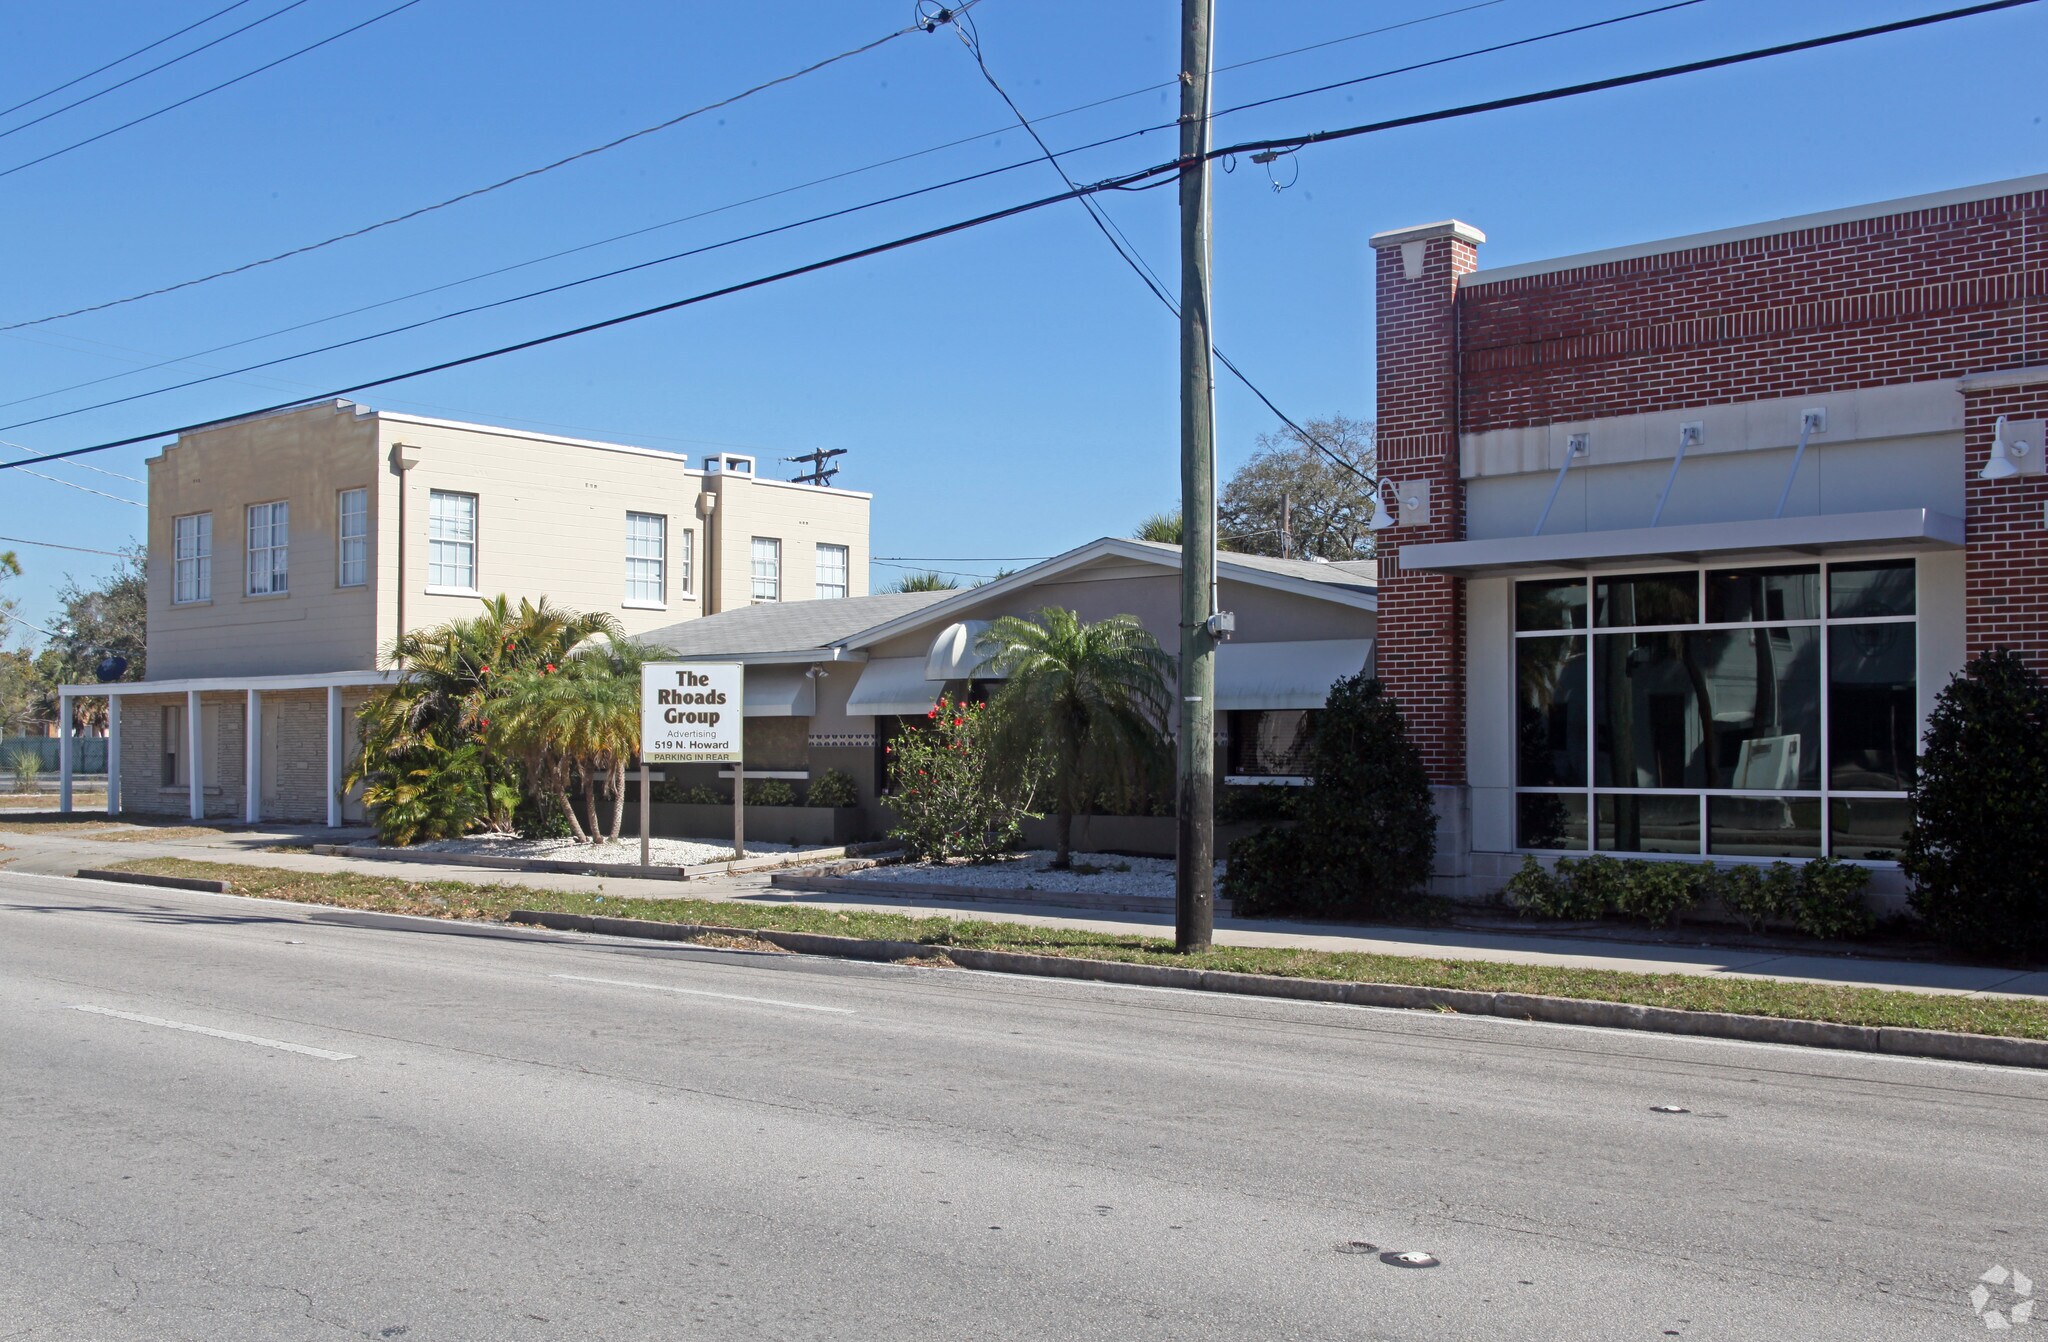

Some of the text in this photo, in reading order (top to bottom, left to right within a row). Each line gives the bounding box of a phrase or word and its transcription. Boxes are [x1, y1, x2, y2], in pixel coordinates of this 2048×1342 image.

[676, 671, 709, 686] The
[658, 689, 726, 704] Rhoads
[664, 708, 720, 727] Group
[667, 730, 716, 739] Advertising
[655, 741, 729, 749] 519 N. Howard
